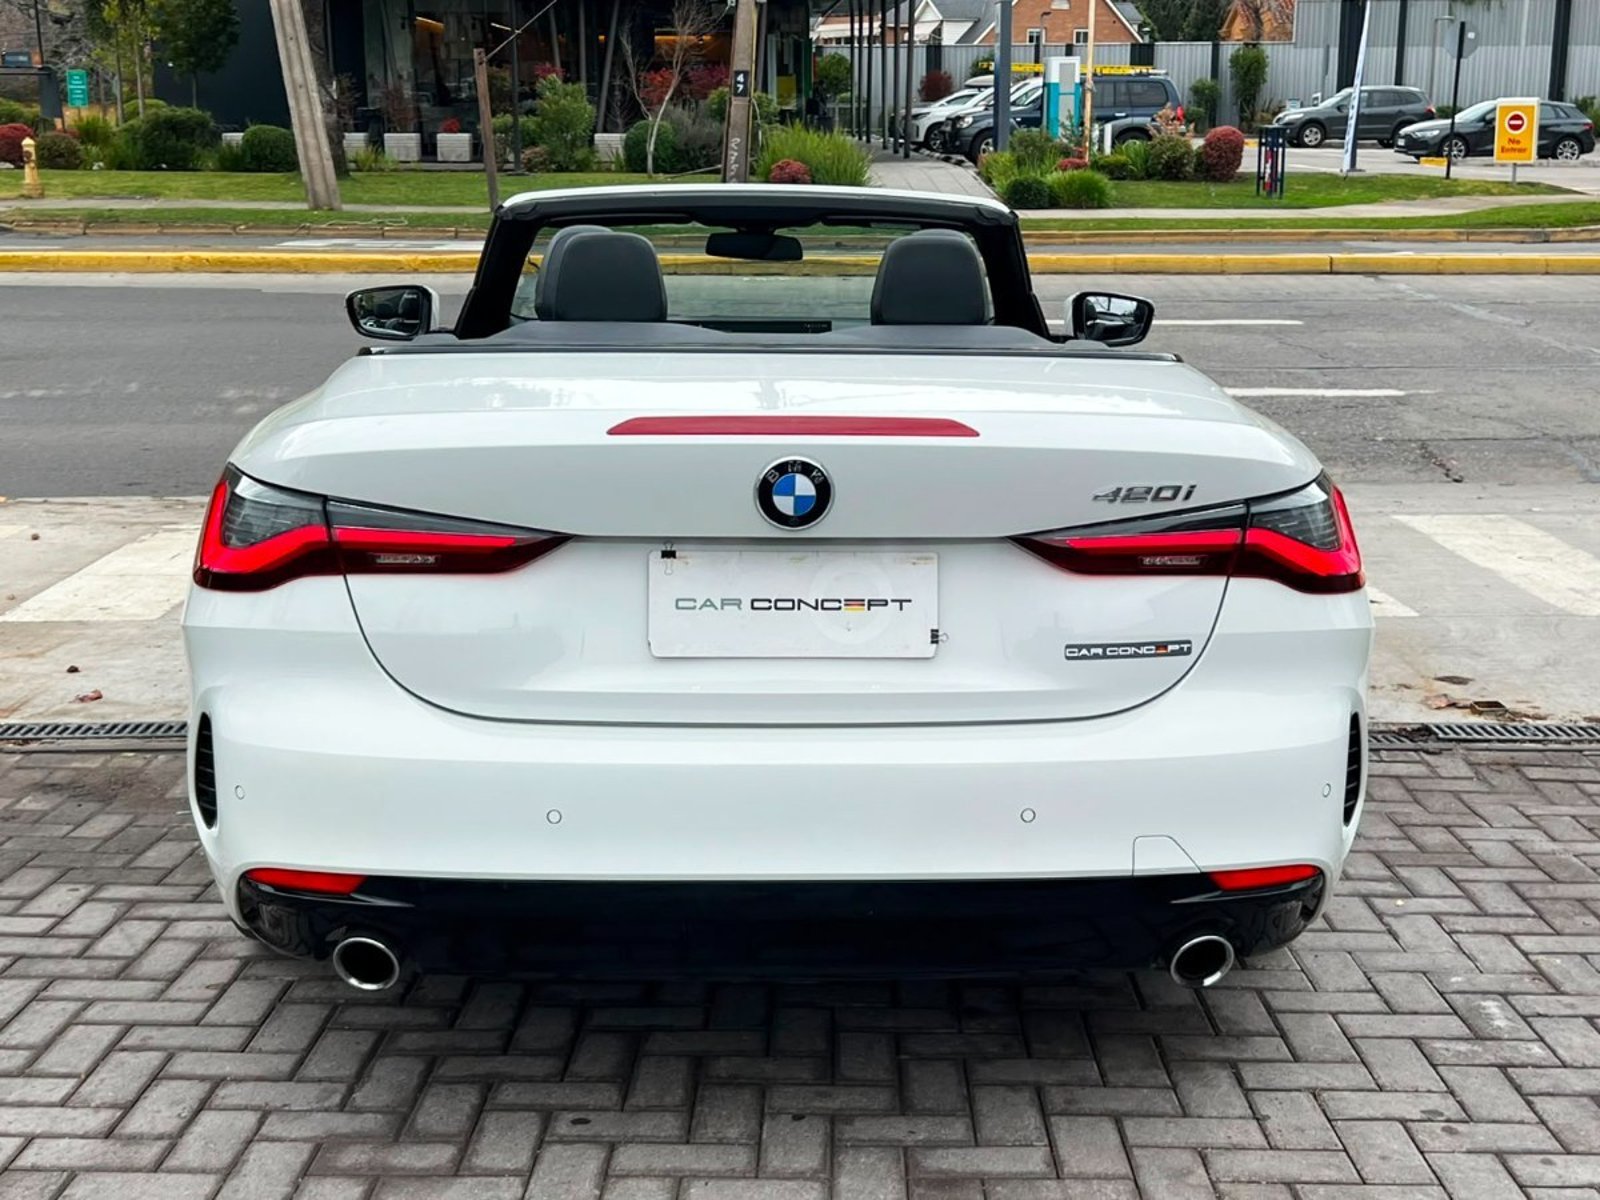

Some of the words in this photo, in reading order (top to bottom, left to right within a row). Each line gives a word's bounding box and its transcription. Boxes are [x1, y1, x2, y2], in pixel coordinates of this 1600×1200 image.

[765, 460, 824, 484] BMW
[1092, 485, 1197, 503] 420i
[675, 598, 742, 611] CAR
[750, 598, 912, 611] CONCEPT
[1065, 647, 1103, 657] CAR
[1106, 644, 1191, 656] CONCEPT
